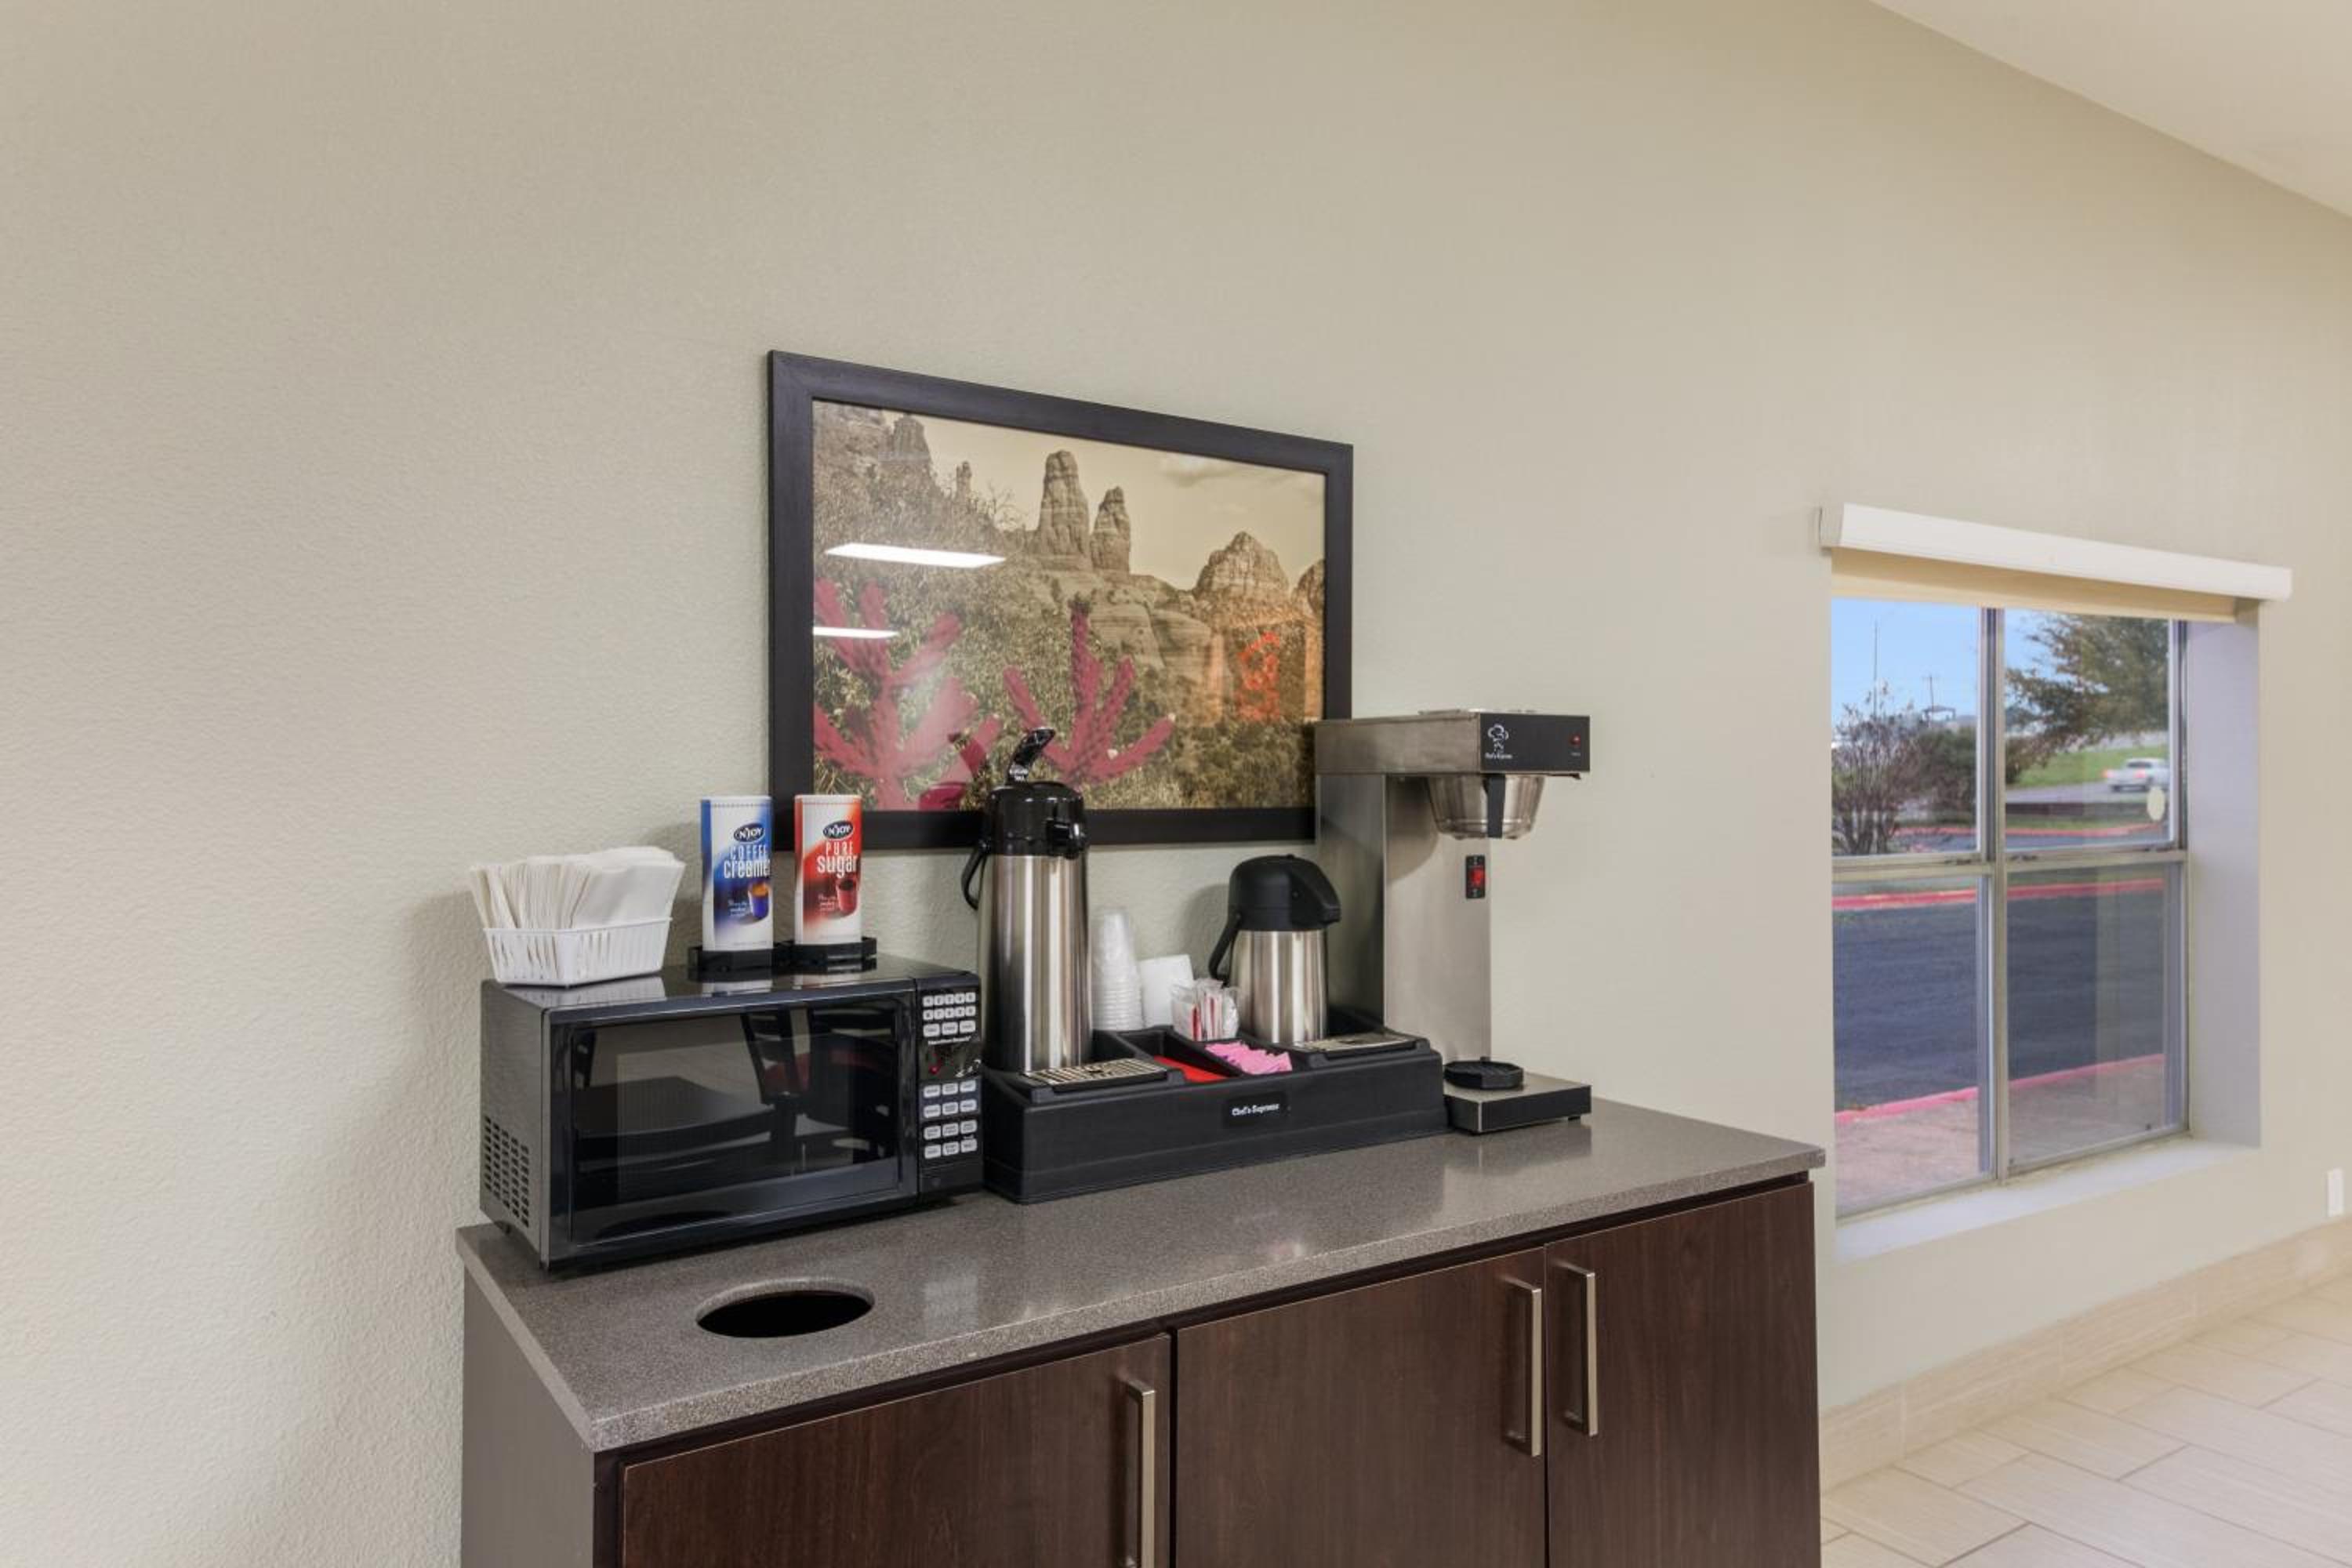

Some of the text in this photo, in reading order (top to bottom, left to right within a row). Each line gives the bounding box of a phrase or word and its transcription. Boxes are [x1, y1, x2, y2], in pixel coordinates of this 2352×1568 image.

[729, 844, 768, 859] COFFEE
[825, 841, 854, 855] PURE
[816, 854, 858, 878] sugar
